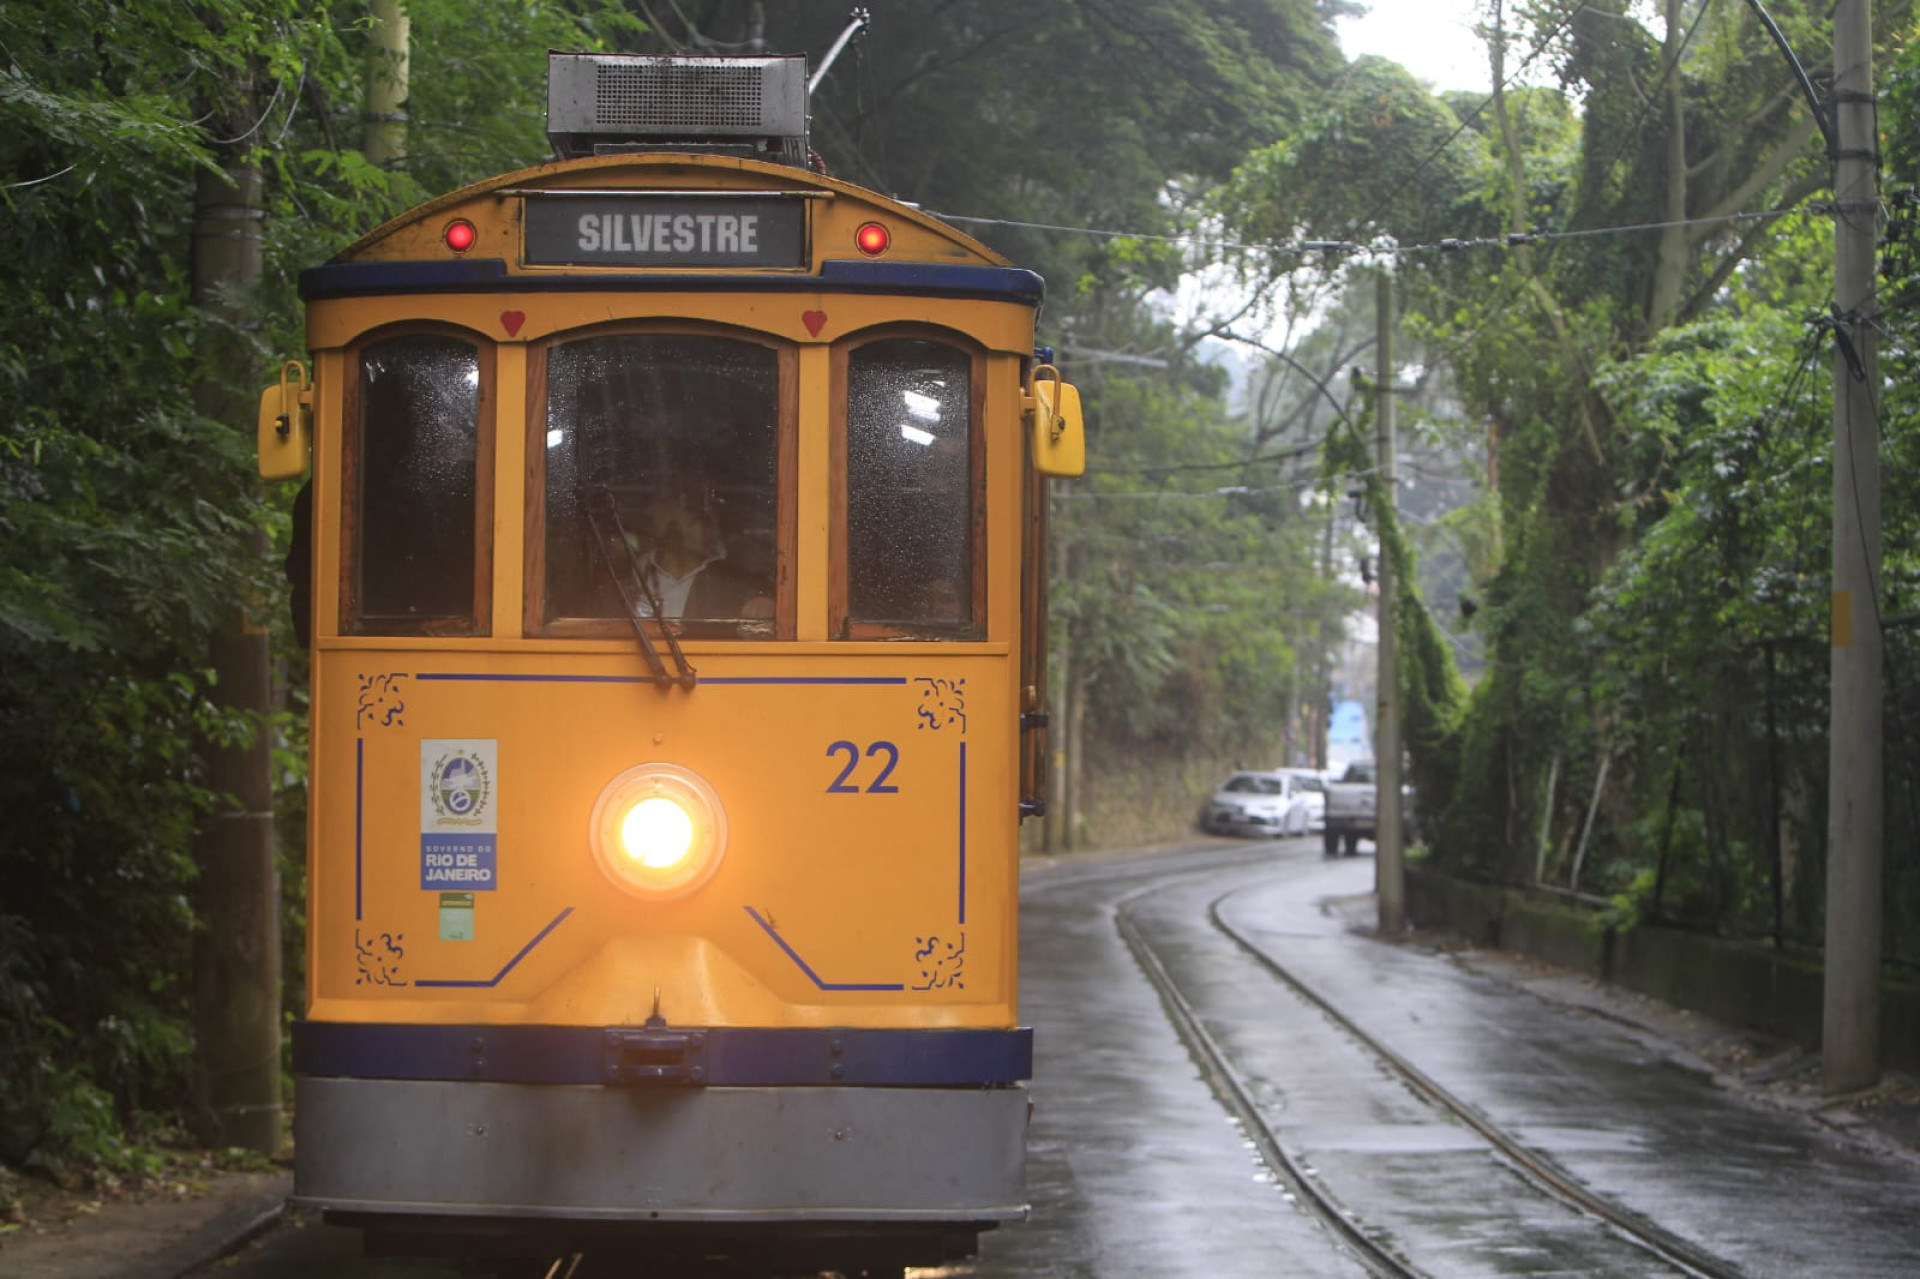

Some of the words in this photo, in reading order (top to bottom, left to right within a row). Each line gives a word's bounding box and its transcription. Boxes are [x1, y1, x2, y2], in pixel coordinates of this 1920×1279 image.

[578, 214, 758, 253] SILVESTRE
[825, 740, 899, 793] 22
[426, 845, 474, 853] GOVERNO
[478, 845, 492, 853] DO
[425, 854, 454, 867] RIO
[456, 854, 478, 867] DE
[425, 868, 492, 882] JANEIRO
